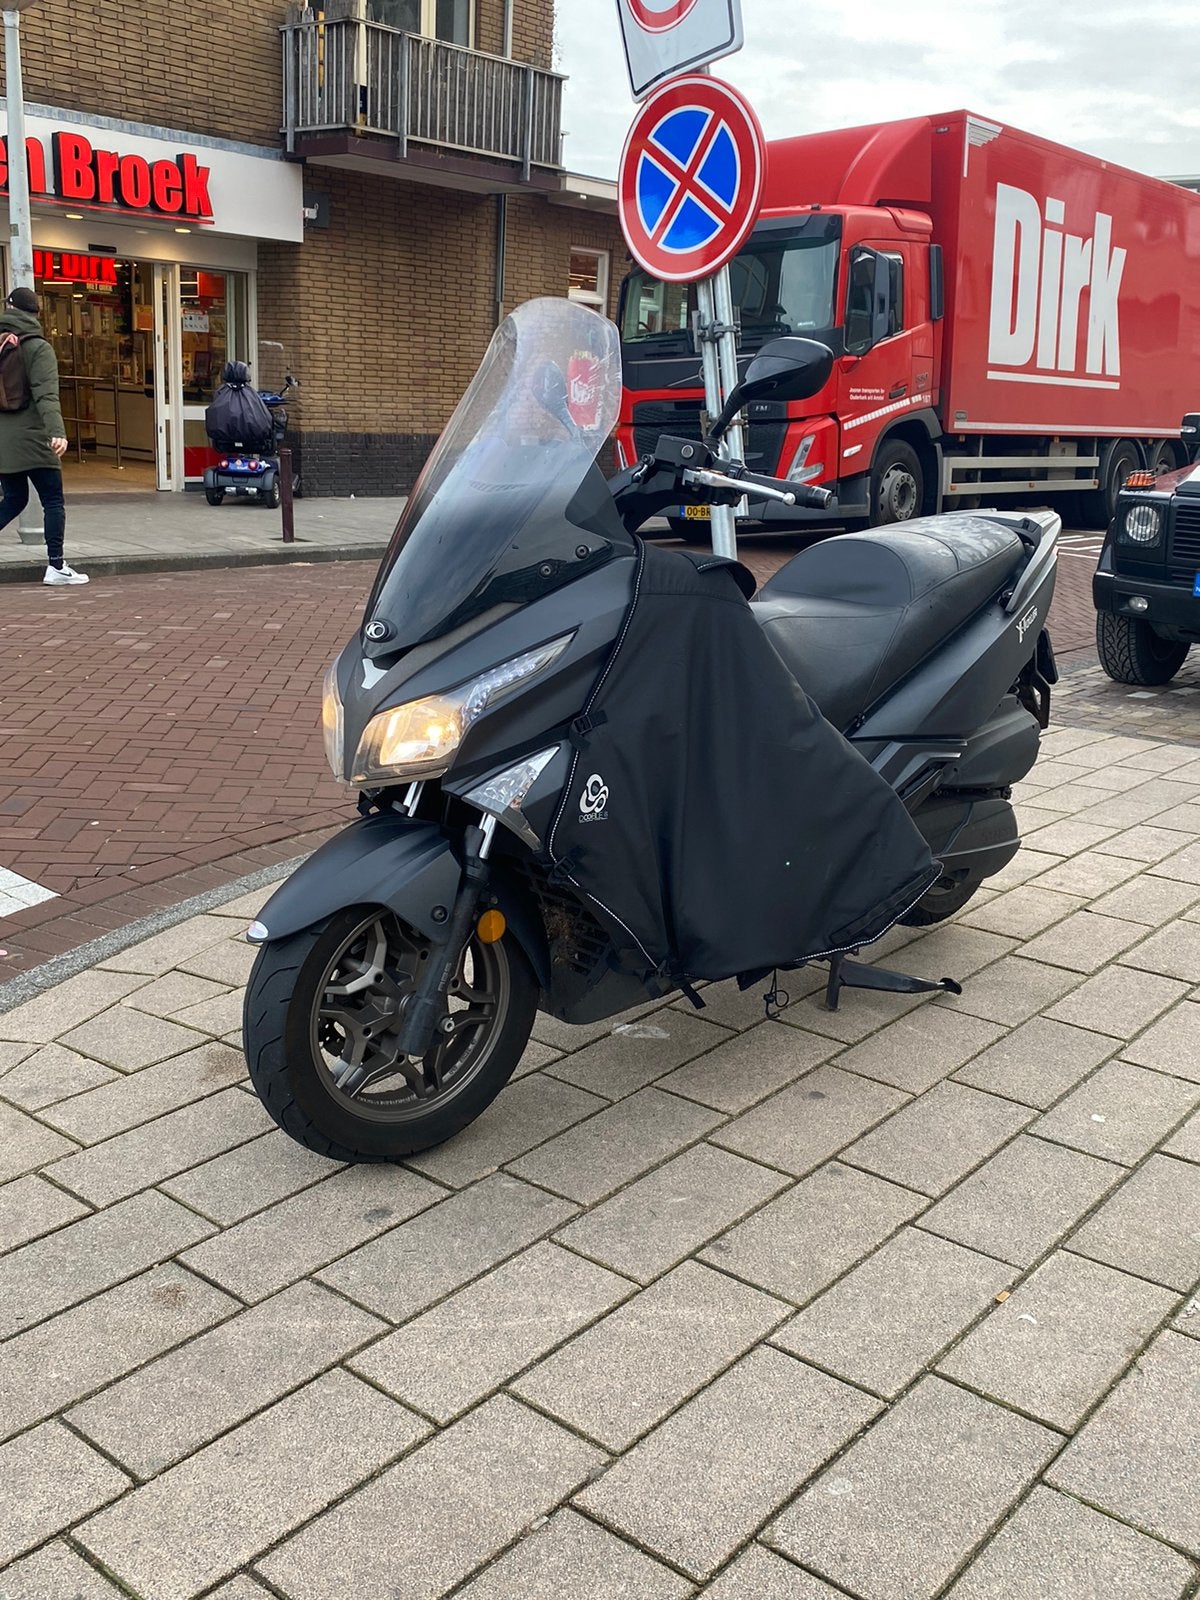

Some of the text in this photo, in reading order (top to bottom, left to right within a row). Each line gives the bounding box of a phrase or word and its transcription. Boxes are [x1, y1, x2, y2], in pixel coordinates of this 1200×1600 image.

[53, 131, 213, 217] Broek
[988, 182, 1127, 376] Dirk
[687, 507, 711, 516] 00-BR
